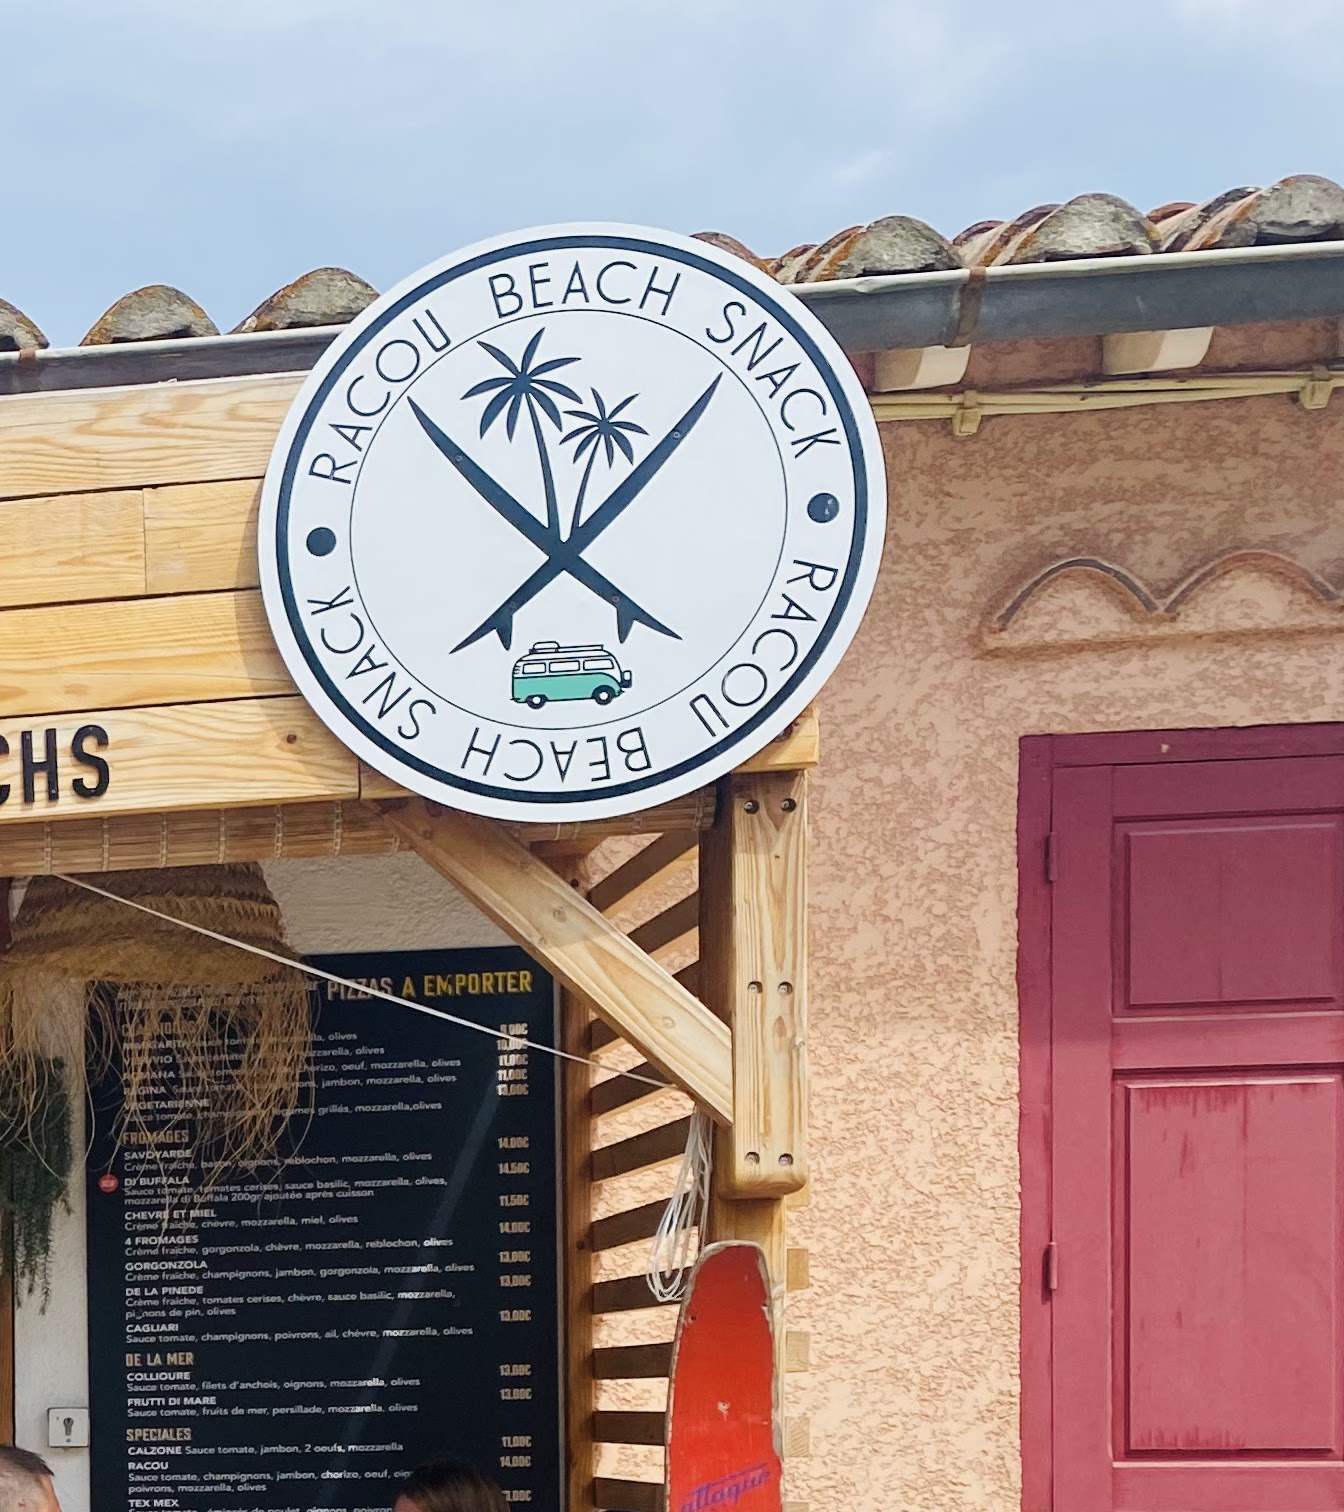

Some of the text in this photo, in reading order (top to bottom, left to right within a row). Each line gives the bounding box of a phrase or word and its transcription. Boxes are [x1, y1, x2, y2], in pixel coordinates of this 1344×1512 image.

[308, 260, 842, 485] RACOU BEACH SNACK
[306, 559, 839, 784] RACOU BEACH SNACK
[328, 971, 532, 1000] PIZZAS A EMPORTER
[123, 1129, 188, 1144] FROMAGES
[124, 1150, 192, 1160] SAVOYARDE
[173, 1211, 186, 1219] ET
[135, 1236, 199, 1245] FROMAGES
[125, 1261, 207, 1271] GORGONZOLA
[202, 1270, 272, 1280] champignons,
[384, 1264, 442, 1274] mozzarella,
[445, 1264, 474, 1272] olives
[126, 1286, 204, 1296] DE LA PINEDE
[169, 1309, 182, 1317] de
[207, 1307, 236, 1315] olives
[126, 1324, 178, 1332] CAGLIARI
[126, 1335, 156, 1343] Sauce
[159, 1334, 198, 1343] tomate,
[201, 1332, 271, 1343] champignons,
[443, 1327, 473, 1335] olives
[126, 1352, 194, 1367] DE LA MER
[127, 1372, 190, 1381] COLLIOURE
[127, 1383, 156, 1392] Sauce
[160, 1383, 199, 1391] tomate,
[391, 1378, 420, 1386] olives
[128, 1397, 216, 1407] FRUTTI DI MARE
[128, 1409, 157, 1417] Sauce
[160, 1408, 199, 1417] tomate,
[202, 1407, 228, 1416] fruits
[231, 1407, 244, 1415] de
[388, 1403, 418, 1412] olives
[126, 1428, 192, 1442] SPECIALES
[128, 1447, 182, 1455] CALZONE
[218, 1446, 257, 1454] tomate,
[260, 1445, 301, 1456] jambon,
[305, 1444, 311, 1453] 2
[348, 1442, 403, 1452] mozzarella
[128, 1462, 169, 1470] RACOU
[153, 1499, 179, 1507] MEX
